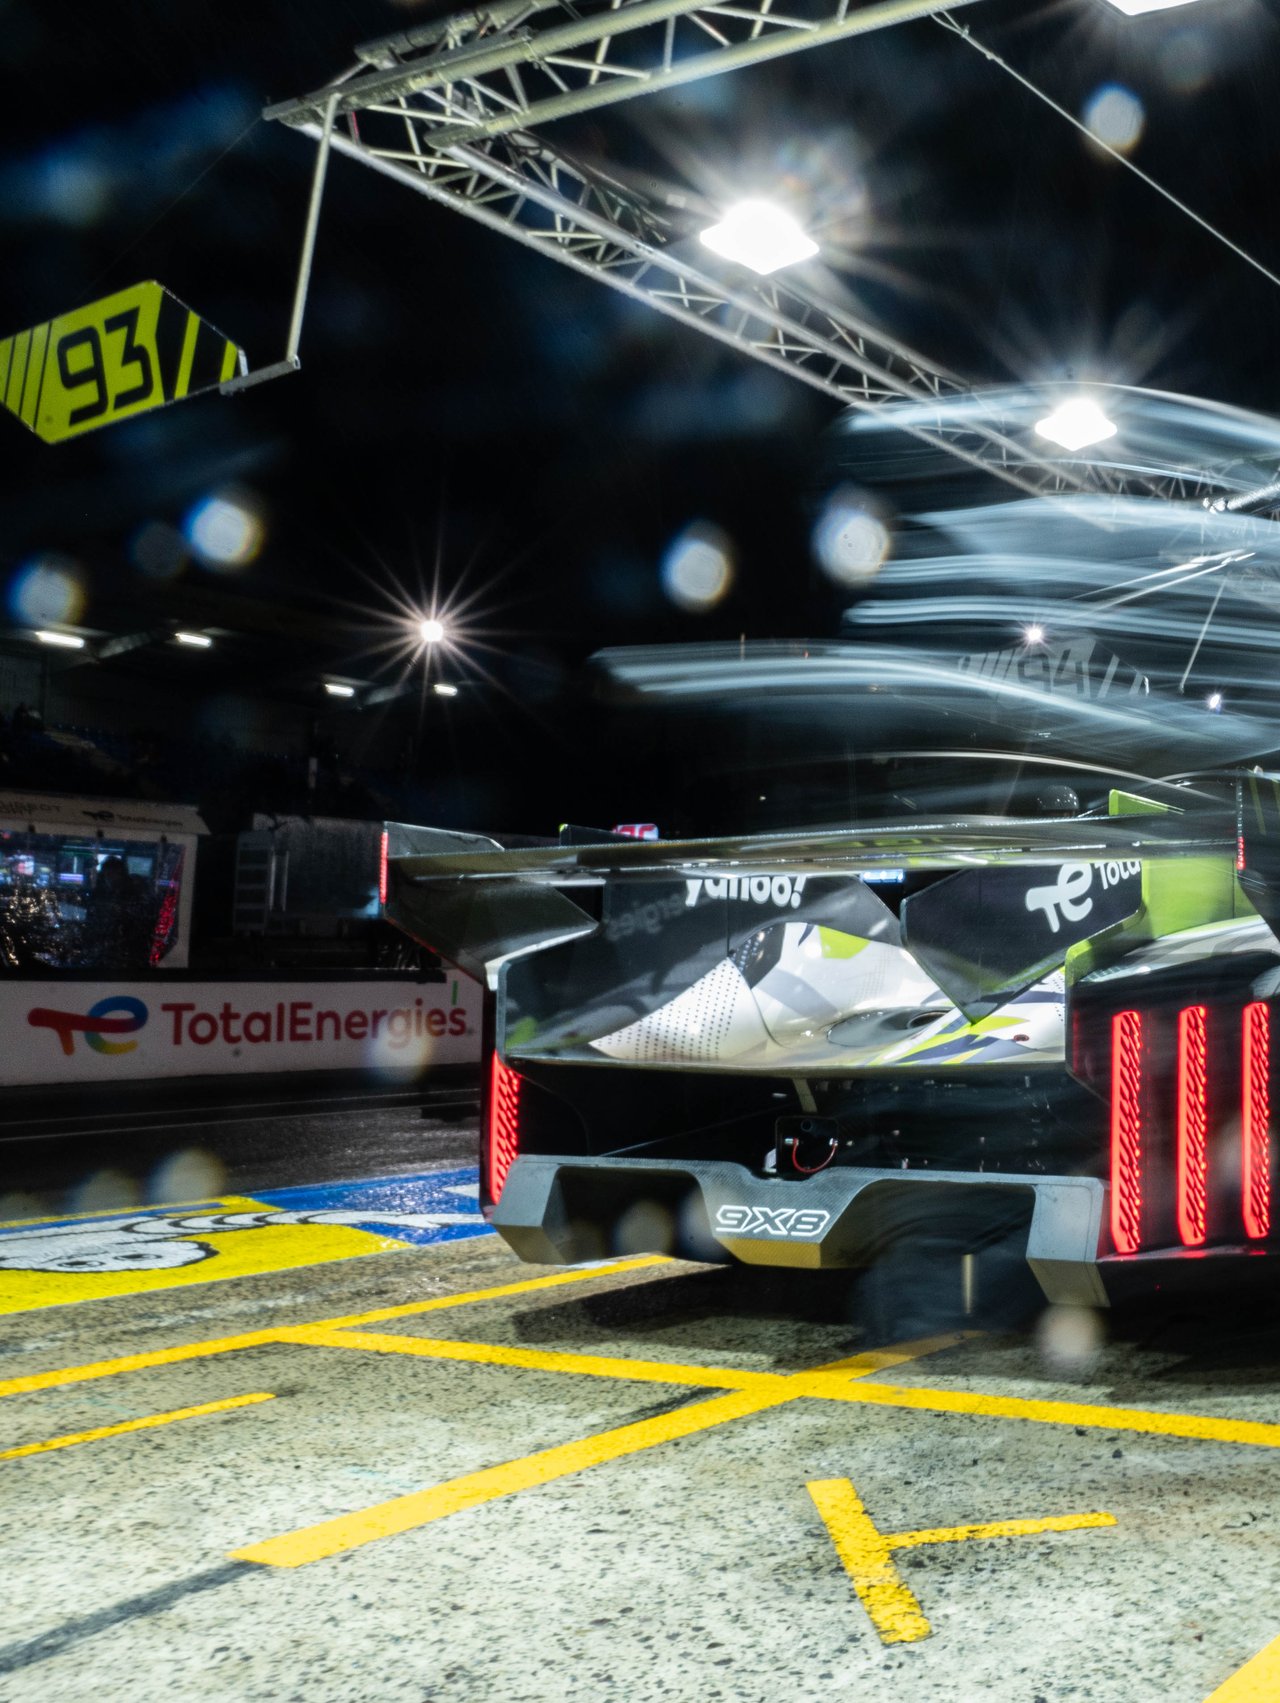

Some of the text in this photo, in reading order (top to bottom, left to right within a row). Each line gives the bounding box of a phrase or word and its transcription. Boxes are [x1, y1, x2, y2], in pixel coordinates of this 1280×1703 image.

[57, 305, 154, 427] 93
[161, 998, 468, 1050] TotalEnergies
[716, 1204, 831, 1237] 9X8
